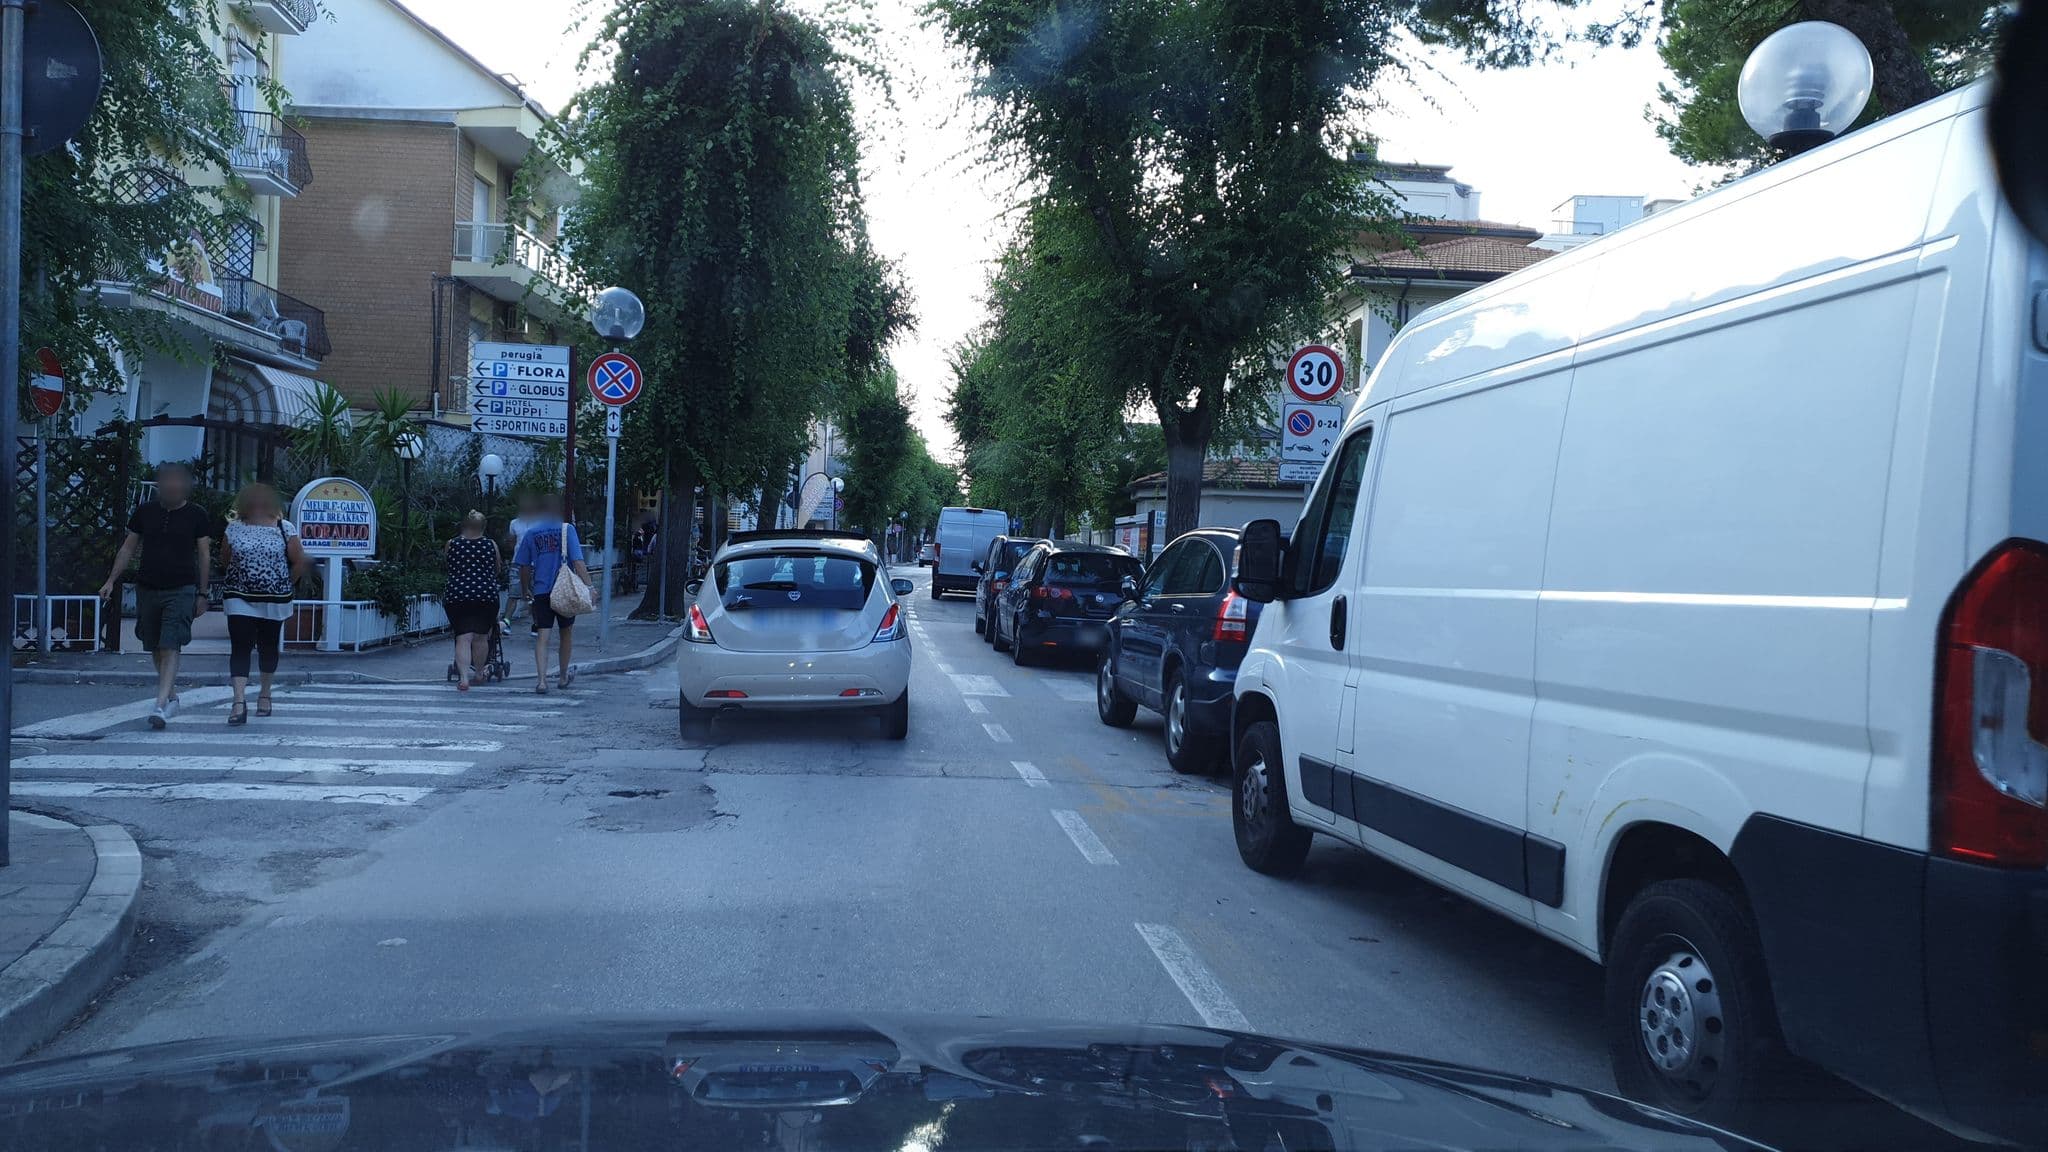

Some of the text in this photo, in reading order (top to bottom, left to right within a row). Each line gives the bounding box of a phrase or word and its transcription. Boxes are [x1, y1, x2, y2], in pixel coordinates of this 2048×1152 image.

[501, 351, 542, 360] perugia
[517, 366, 566, 378] FLORA
[1300, 360, 1332, 387] 30
[519, 385, 565, 396] GLOBUS
[505, 407, 542, 417] PUPPI
[495, 420, 545, 432] SPORTING
[1317, 419, 1338, 429] 0-24
[303, 512, 368, 523] BED & BREAKFAST
[303, 524, 368, 539] CORALLO
